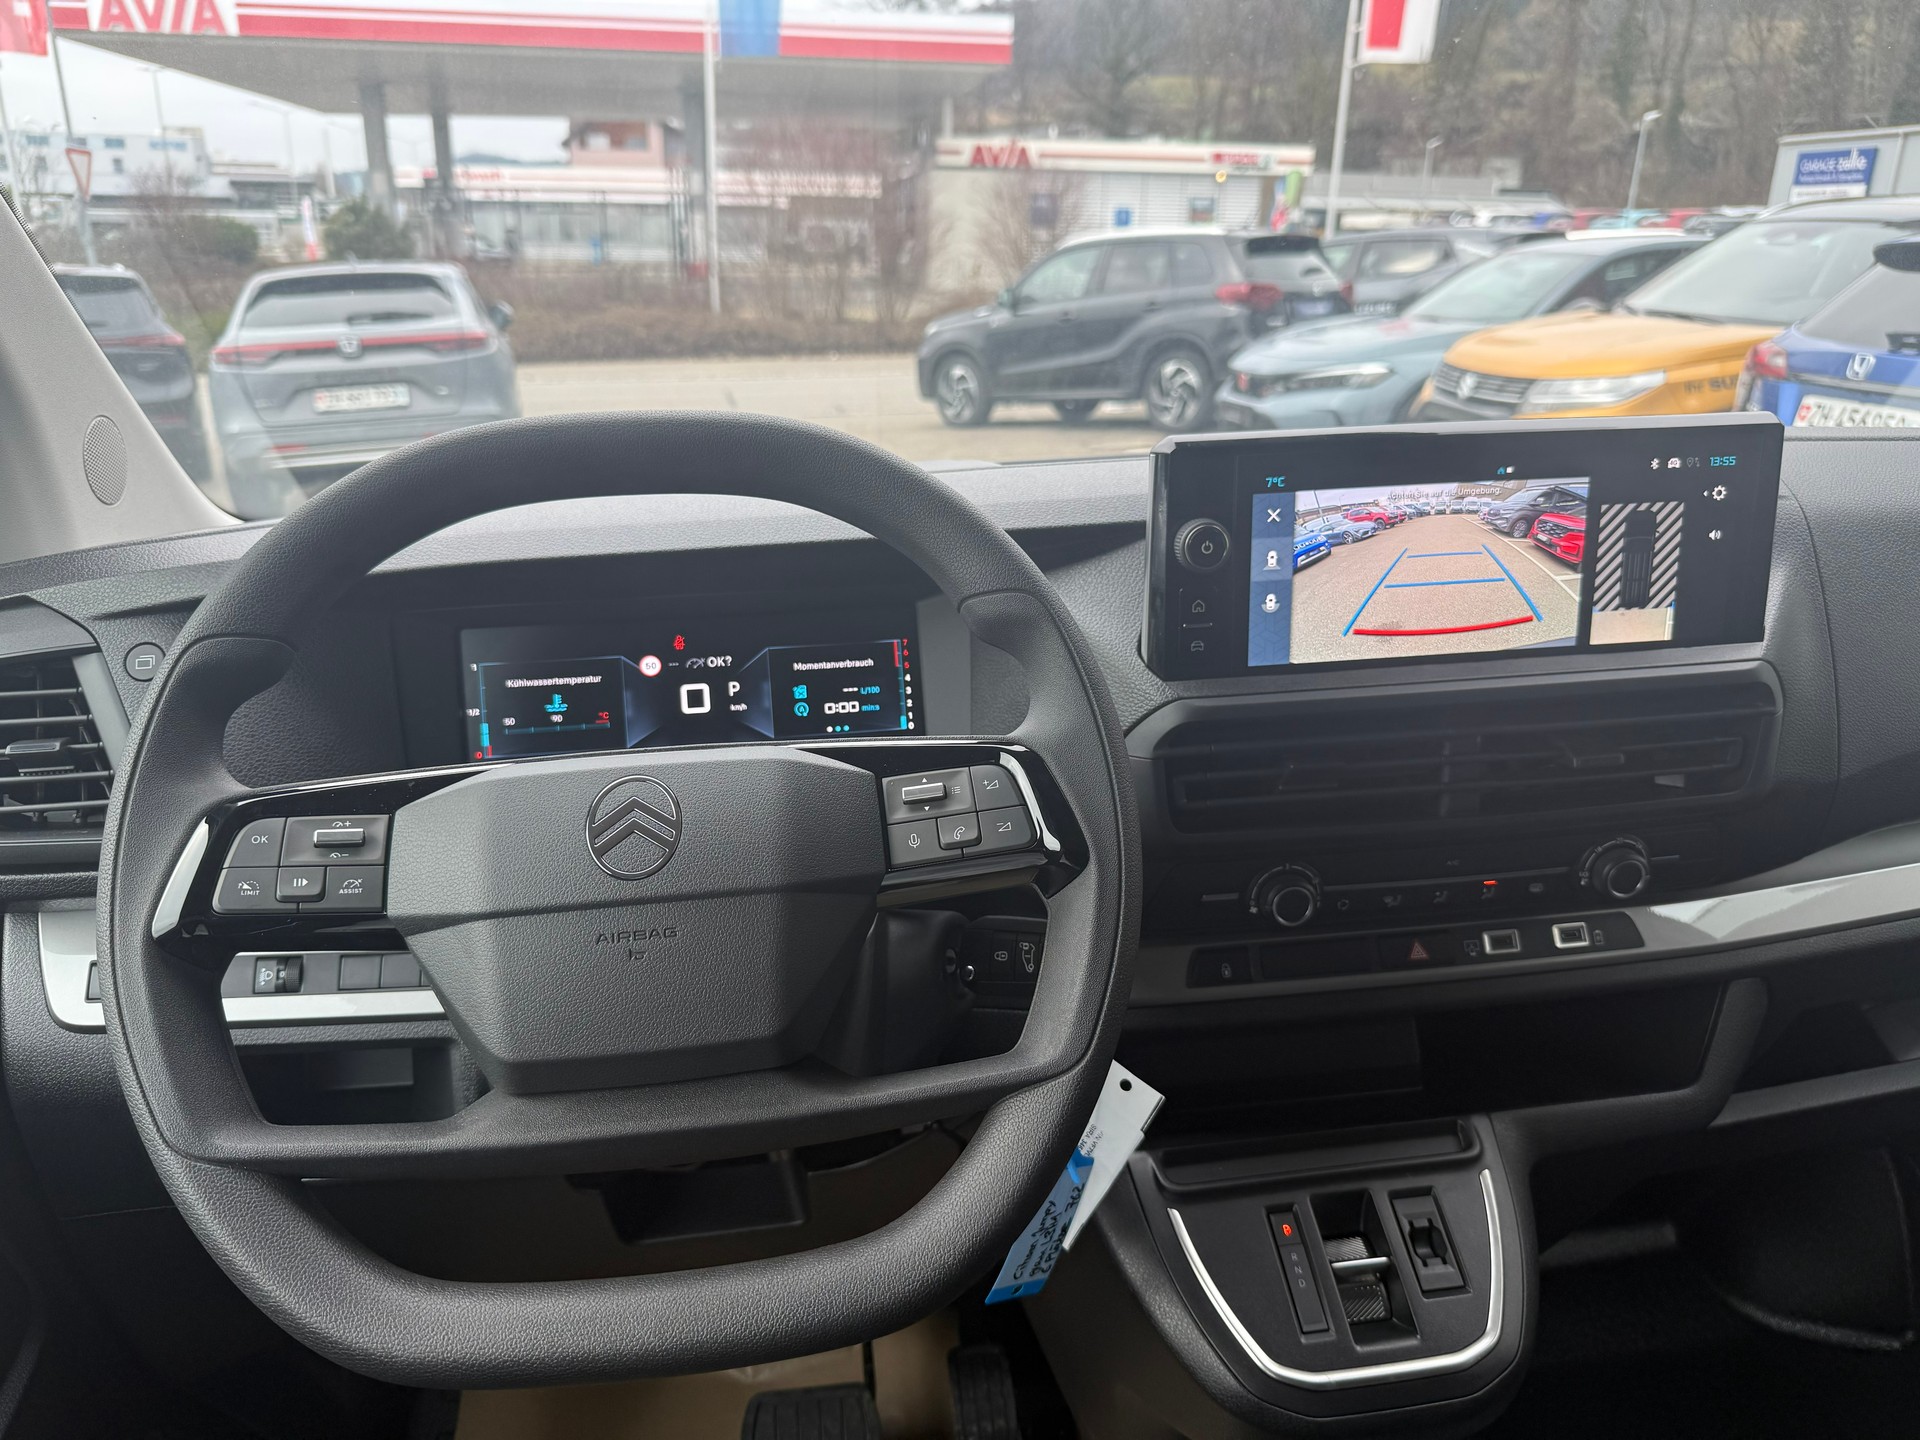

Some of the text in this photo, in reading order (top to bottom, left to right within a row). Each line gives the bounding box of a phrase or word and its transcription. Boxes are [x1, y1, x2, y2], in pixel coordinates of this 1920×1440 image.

[98, 0, 228, 36] AVIA
[969, 144, 1031, 168] AVIA
[1710, 456, 1736, 466] 13:55
[1458, 486, 1502, 497] Umgebung.
[645, 662, 657, 670] 50
[706, 655, 732, 668] OK?
[793, 658, 874, 671] Momentanverbrauch
[505, 675, 602, 688] Kühlwassertemperatur
[904, 673, 911, 682] 4
[728, 681, 740, 697] P
[905, 686, 912, 695] 3
[680, 682, 711, 714] 0
[906, 699, 913, 707] 2
[824, 701, 860, 715] 0:00
[550, 714, 563, 723] 90
[251, 835, 269, 844] OK
[596, 926, 679, 945] AIRBAG
